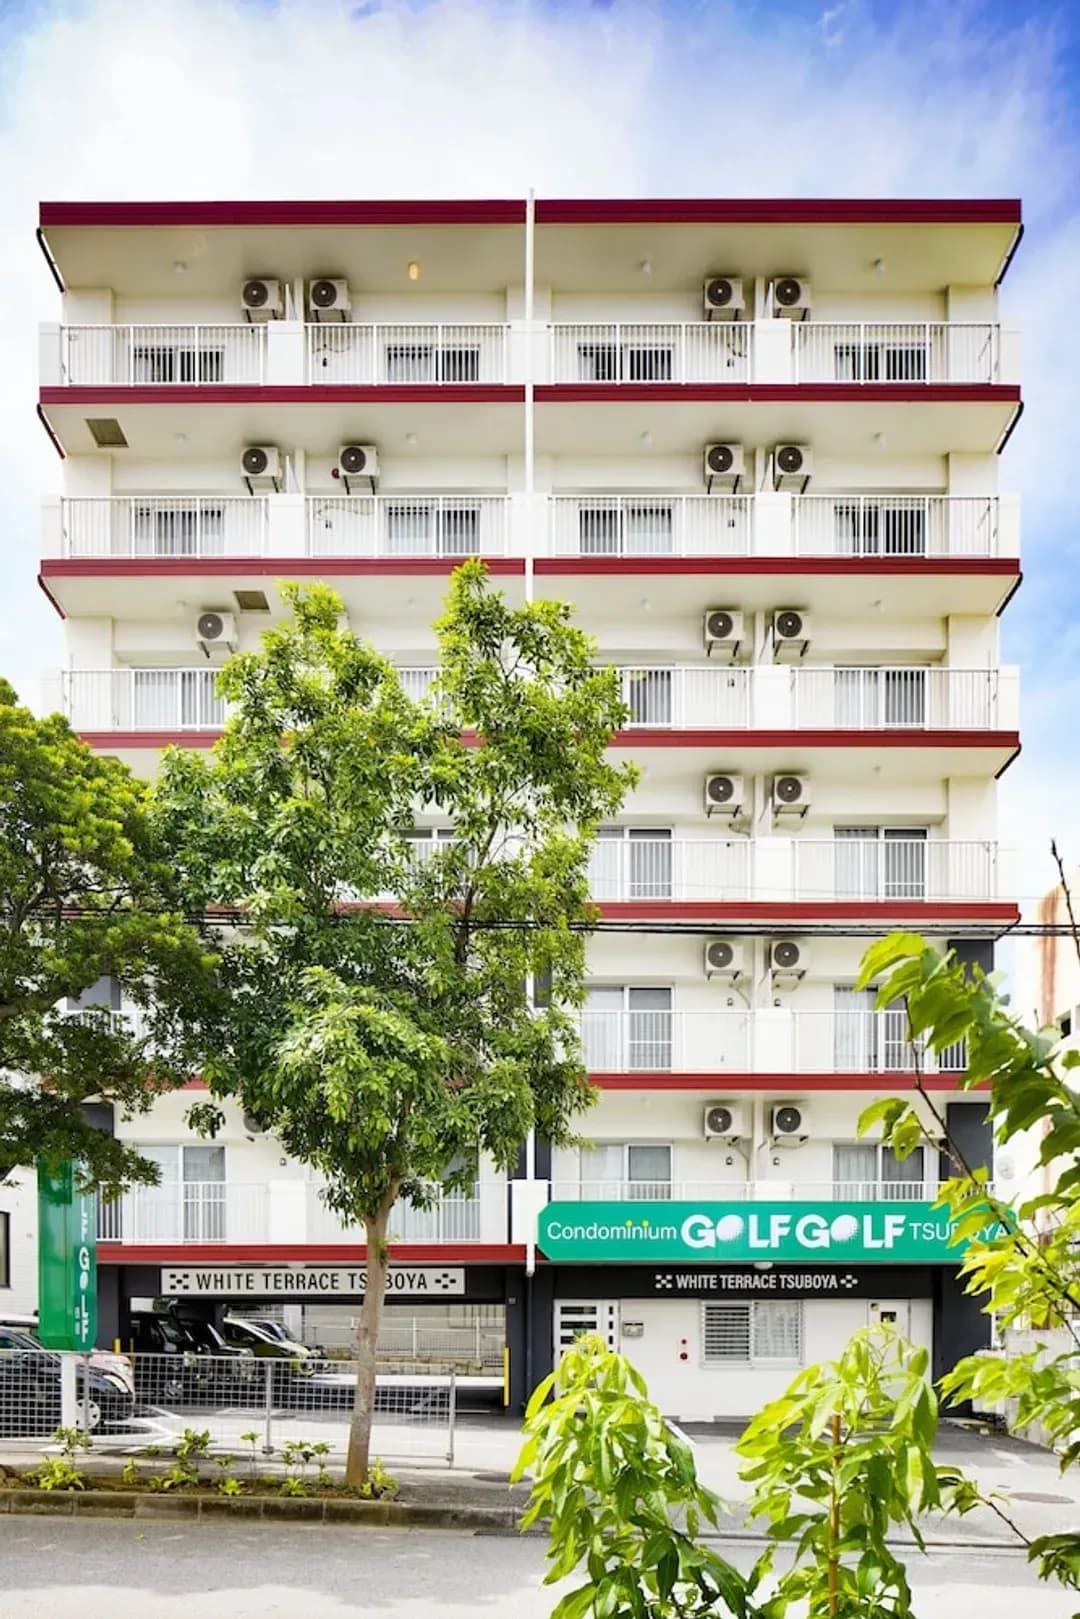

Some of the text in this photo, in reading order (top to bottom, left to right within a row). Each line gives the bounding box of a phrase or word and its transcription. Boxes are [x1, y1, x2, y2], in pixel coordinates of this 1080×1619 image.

[547, 1214, 1007, 1249] Condominium GOLF GOLF TSUYA
[196, 1273, 428, 1291] WHITE TERRACE TSBOYA
[676, 1274, 838, 1290] WHITE TERRACE TSUBOYA
